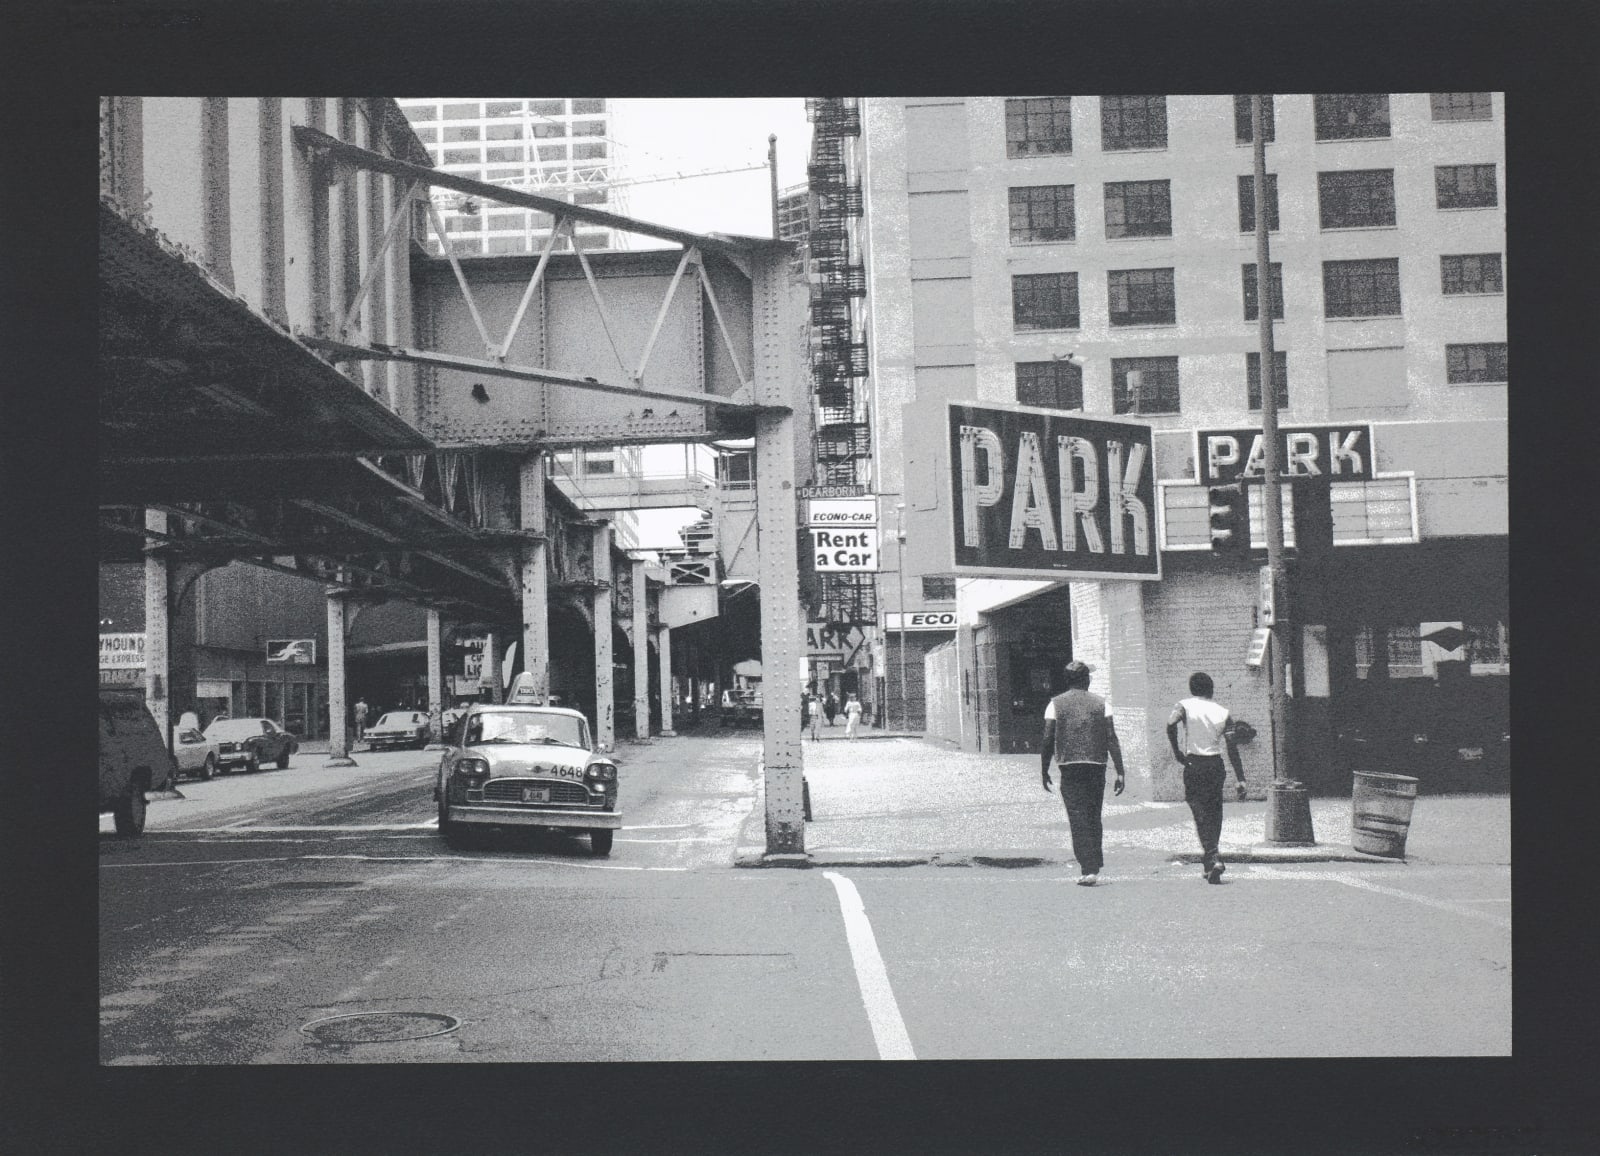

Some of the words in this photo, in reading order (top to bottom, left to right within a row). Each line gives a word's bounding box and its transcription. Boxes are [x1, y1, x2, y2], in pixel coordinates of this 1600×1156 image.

[802, 486, 856, 498] DEARBORN
[959, 425, 1150, 556] PARK
[813, 513, 872, 521] ECONO-CAR
[816, 531, 868, 548] Rent
[816, 553, 829, 566] a
[833, 550, 872, 567] Car
[911, 614, 957, 625] ECO
[112, 654, 145, 664] EXPRESS
[550, 764, 583, 778] 4648
